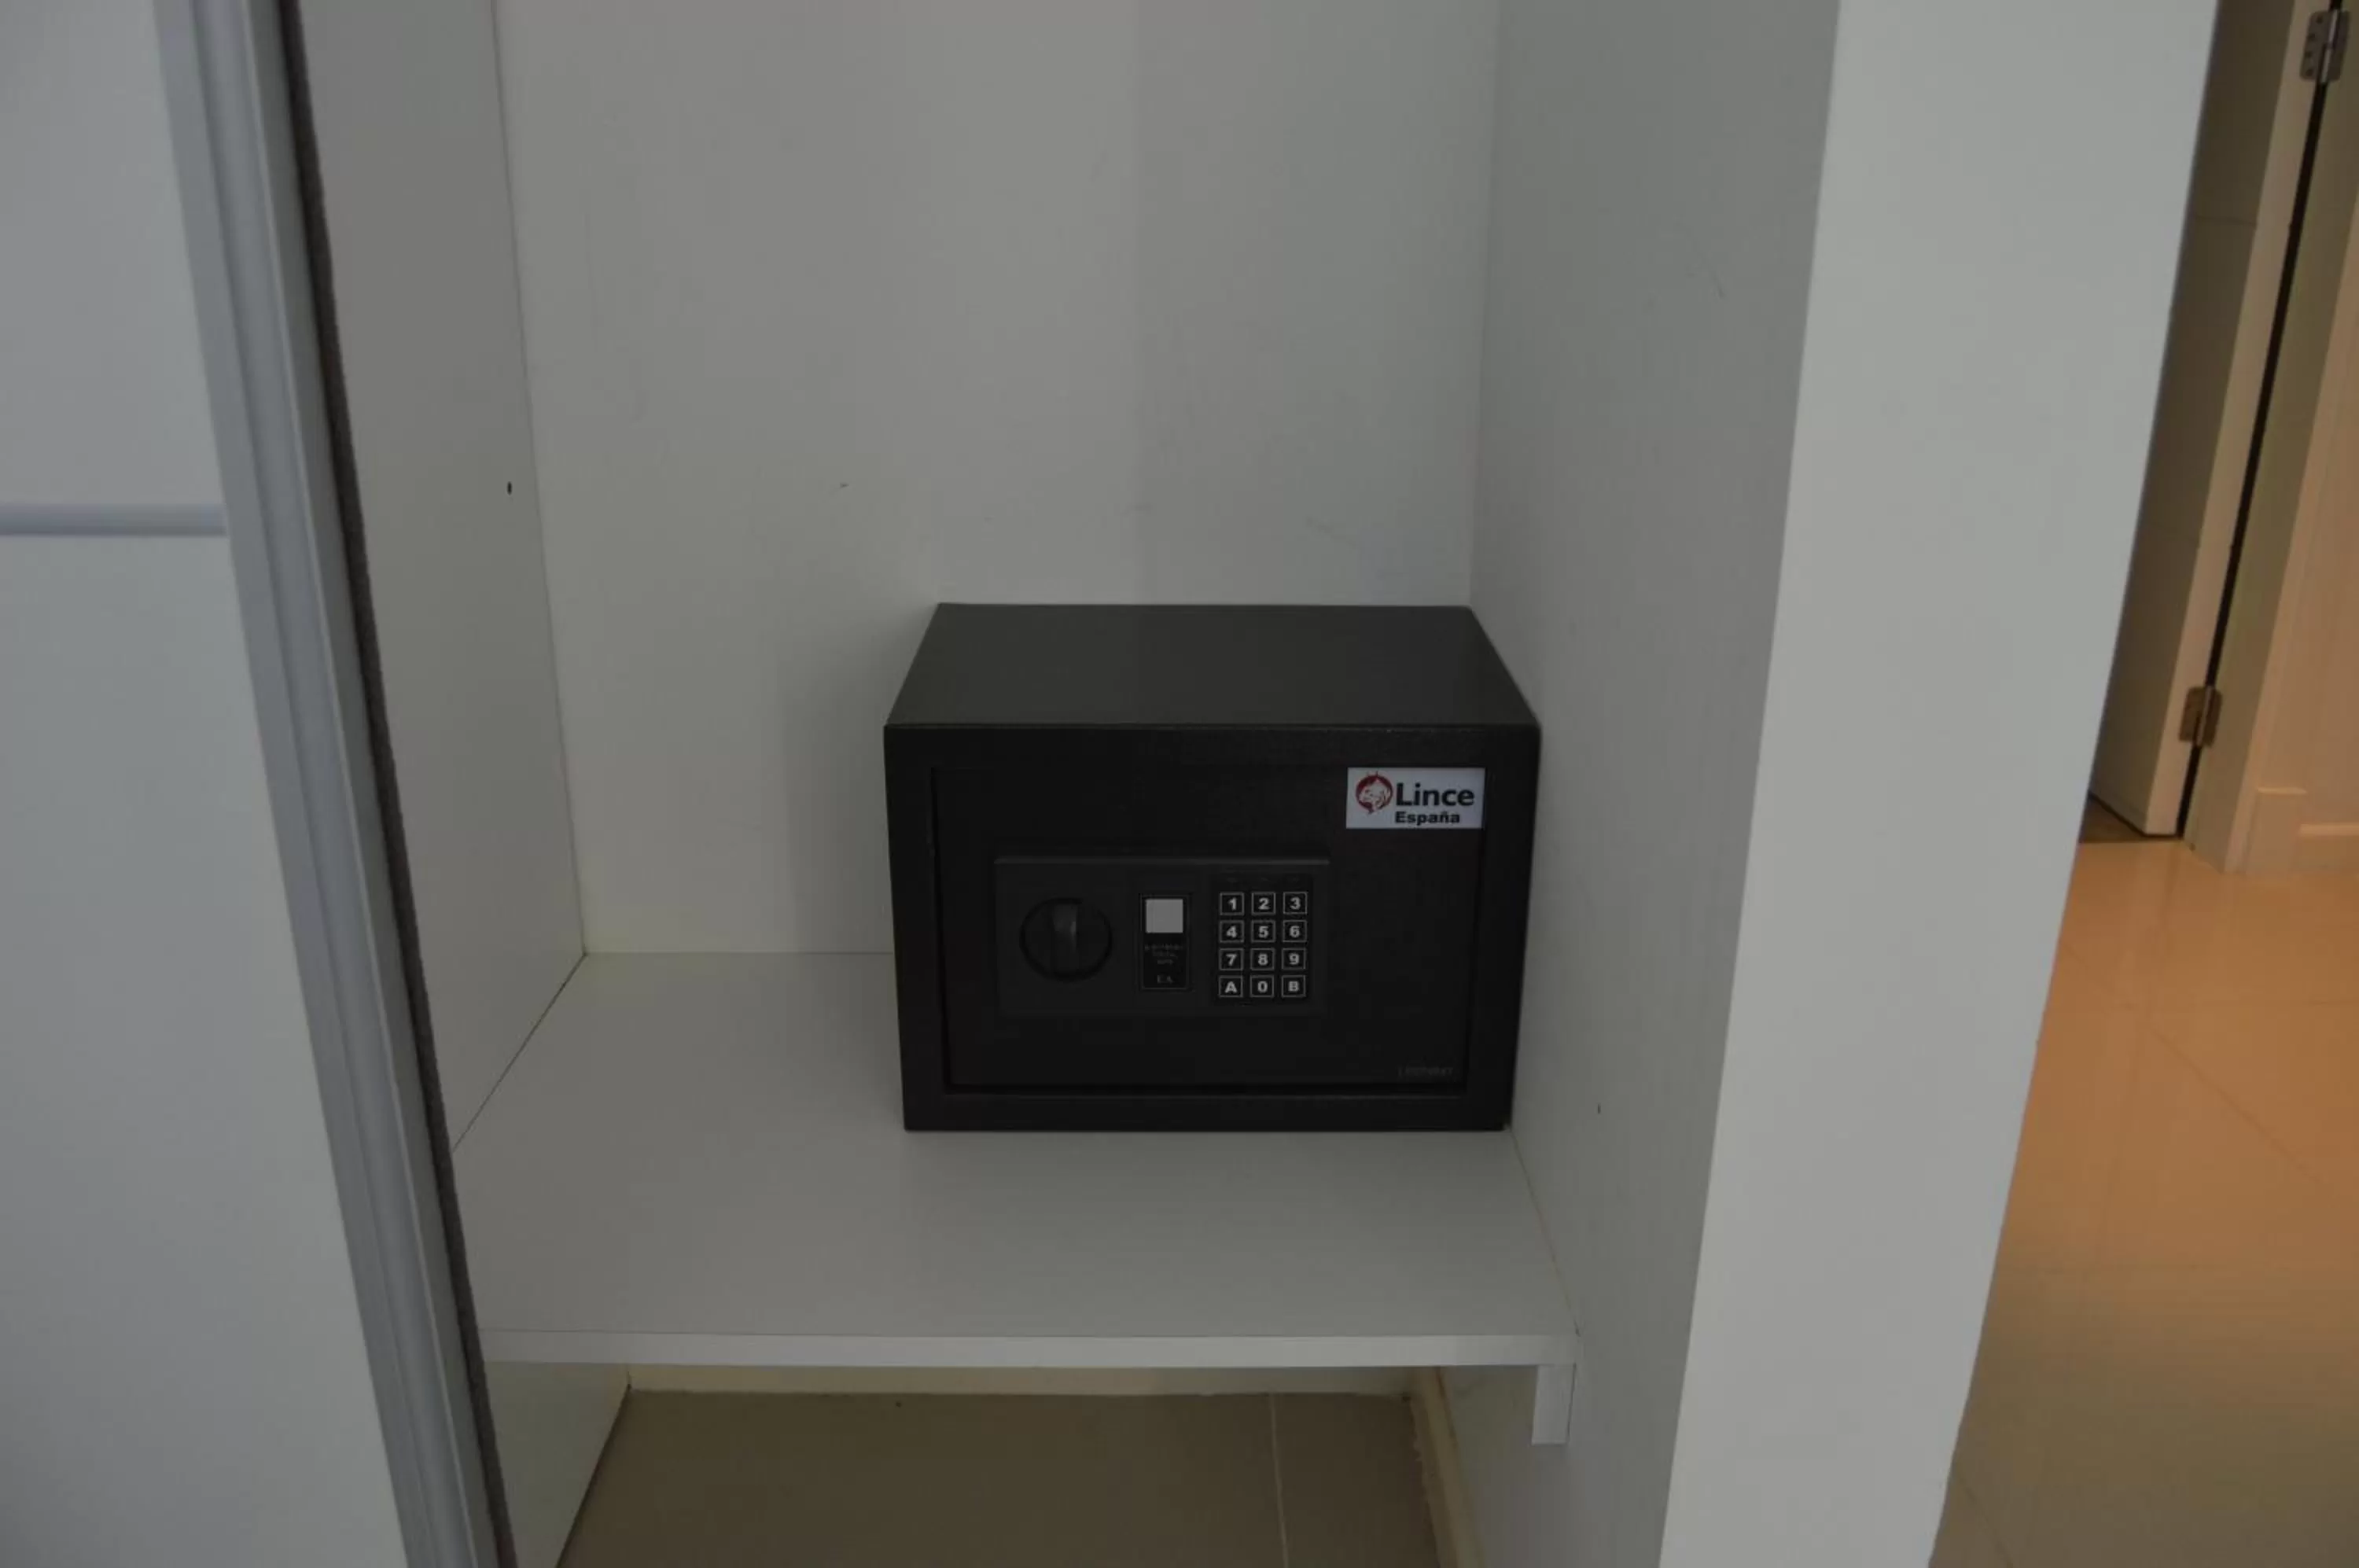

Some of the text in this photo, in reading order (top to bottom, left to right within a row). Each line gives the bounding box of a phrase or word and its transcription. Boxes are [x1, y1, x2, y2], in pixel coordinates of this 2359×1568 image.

[1396, 782, 1475, 807] Lince
[1394, 810, 1460, 826] España
[1227, 896, 1301, 911] 1 2 3
[1226, 925, 1301, 939] 4 5 6
[1225, 952, 1300, 966] 7 8 9
[1224, 980, 1300, 993] A 0 B
